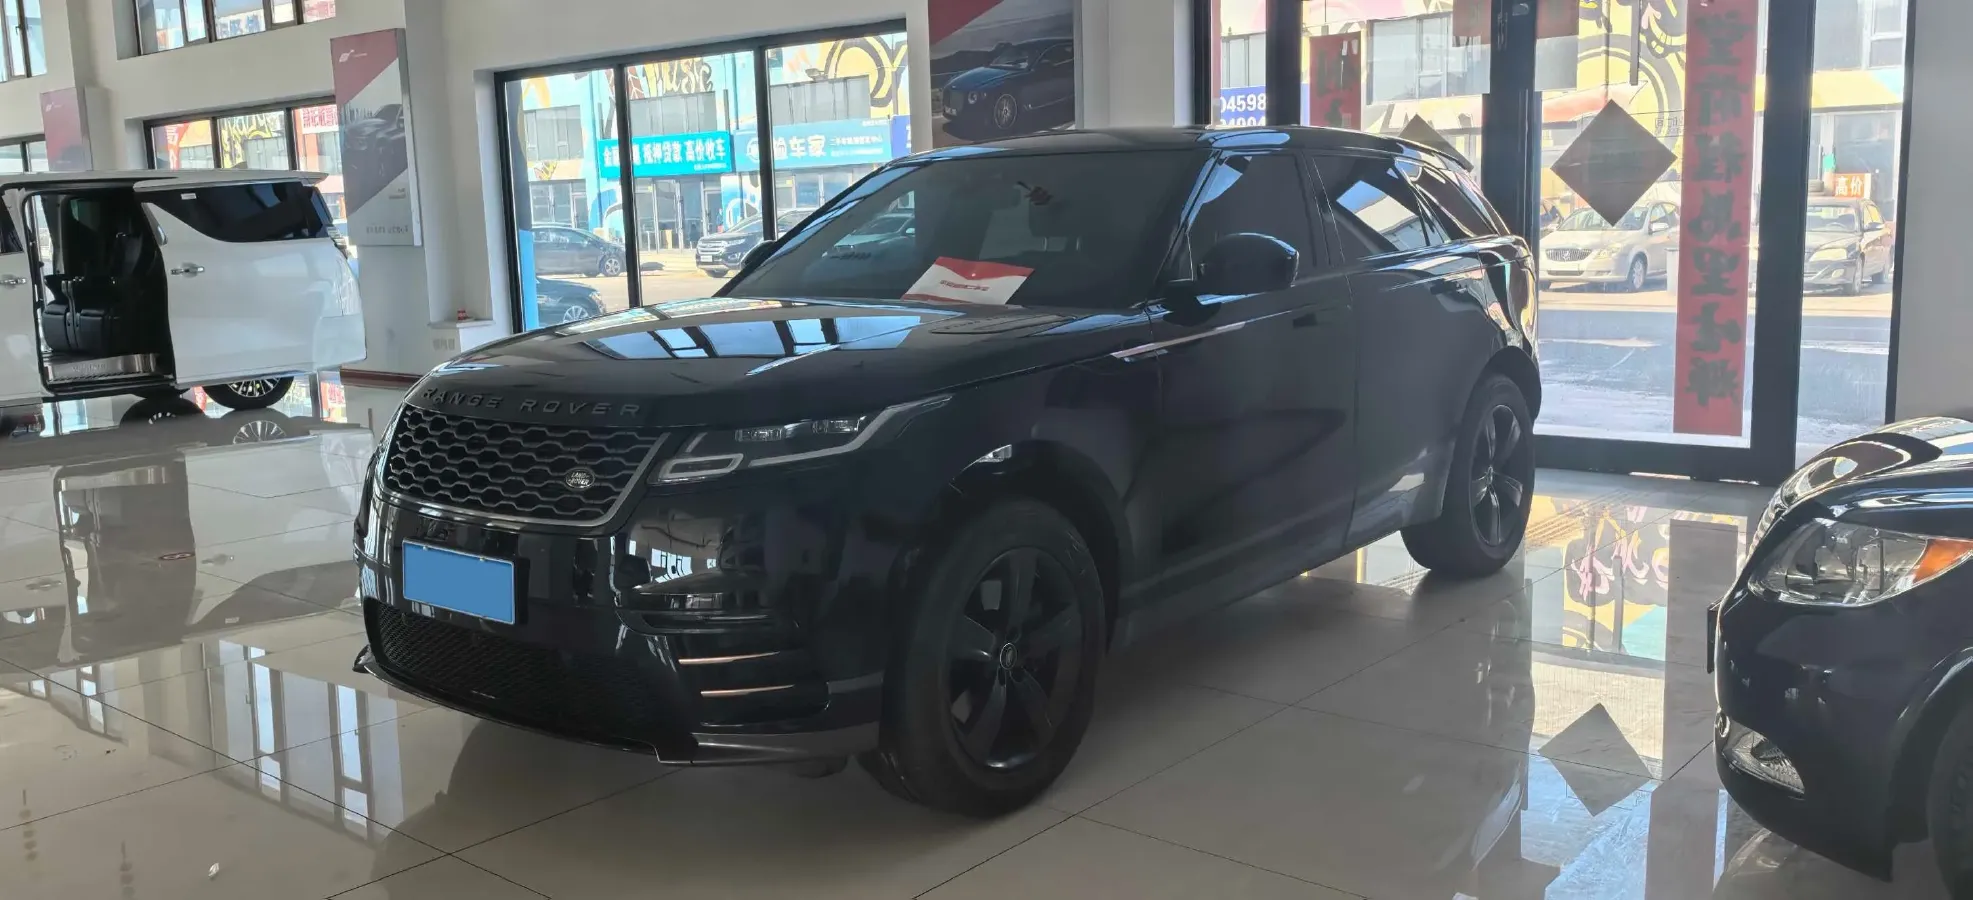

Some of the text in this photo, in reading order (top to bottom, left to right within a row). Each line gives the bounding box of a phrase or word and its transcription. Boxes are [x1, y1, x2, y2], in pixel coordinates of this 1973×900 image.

[684, 136, 726, 162] 高价收车
[1835, 175, 1863, 197] 高价
[421, 387, 641, 418] RANGE ROVER
